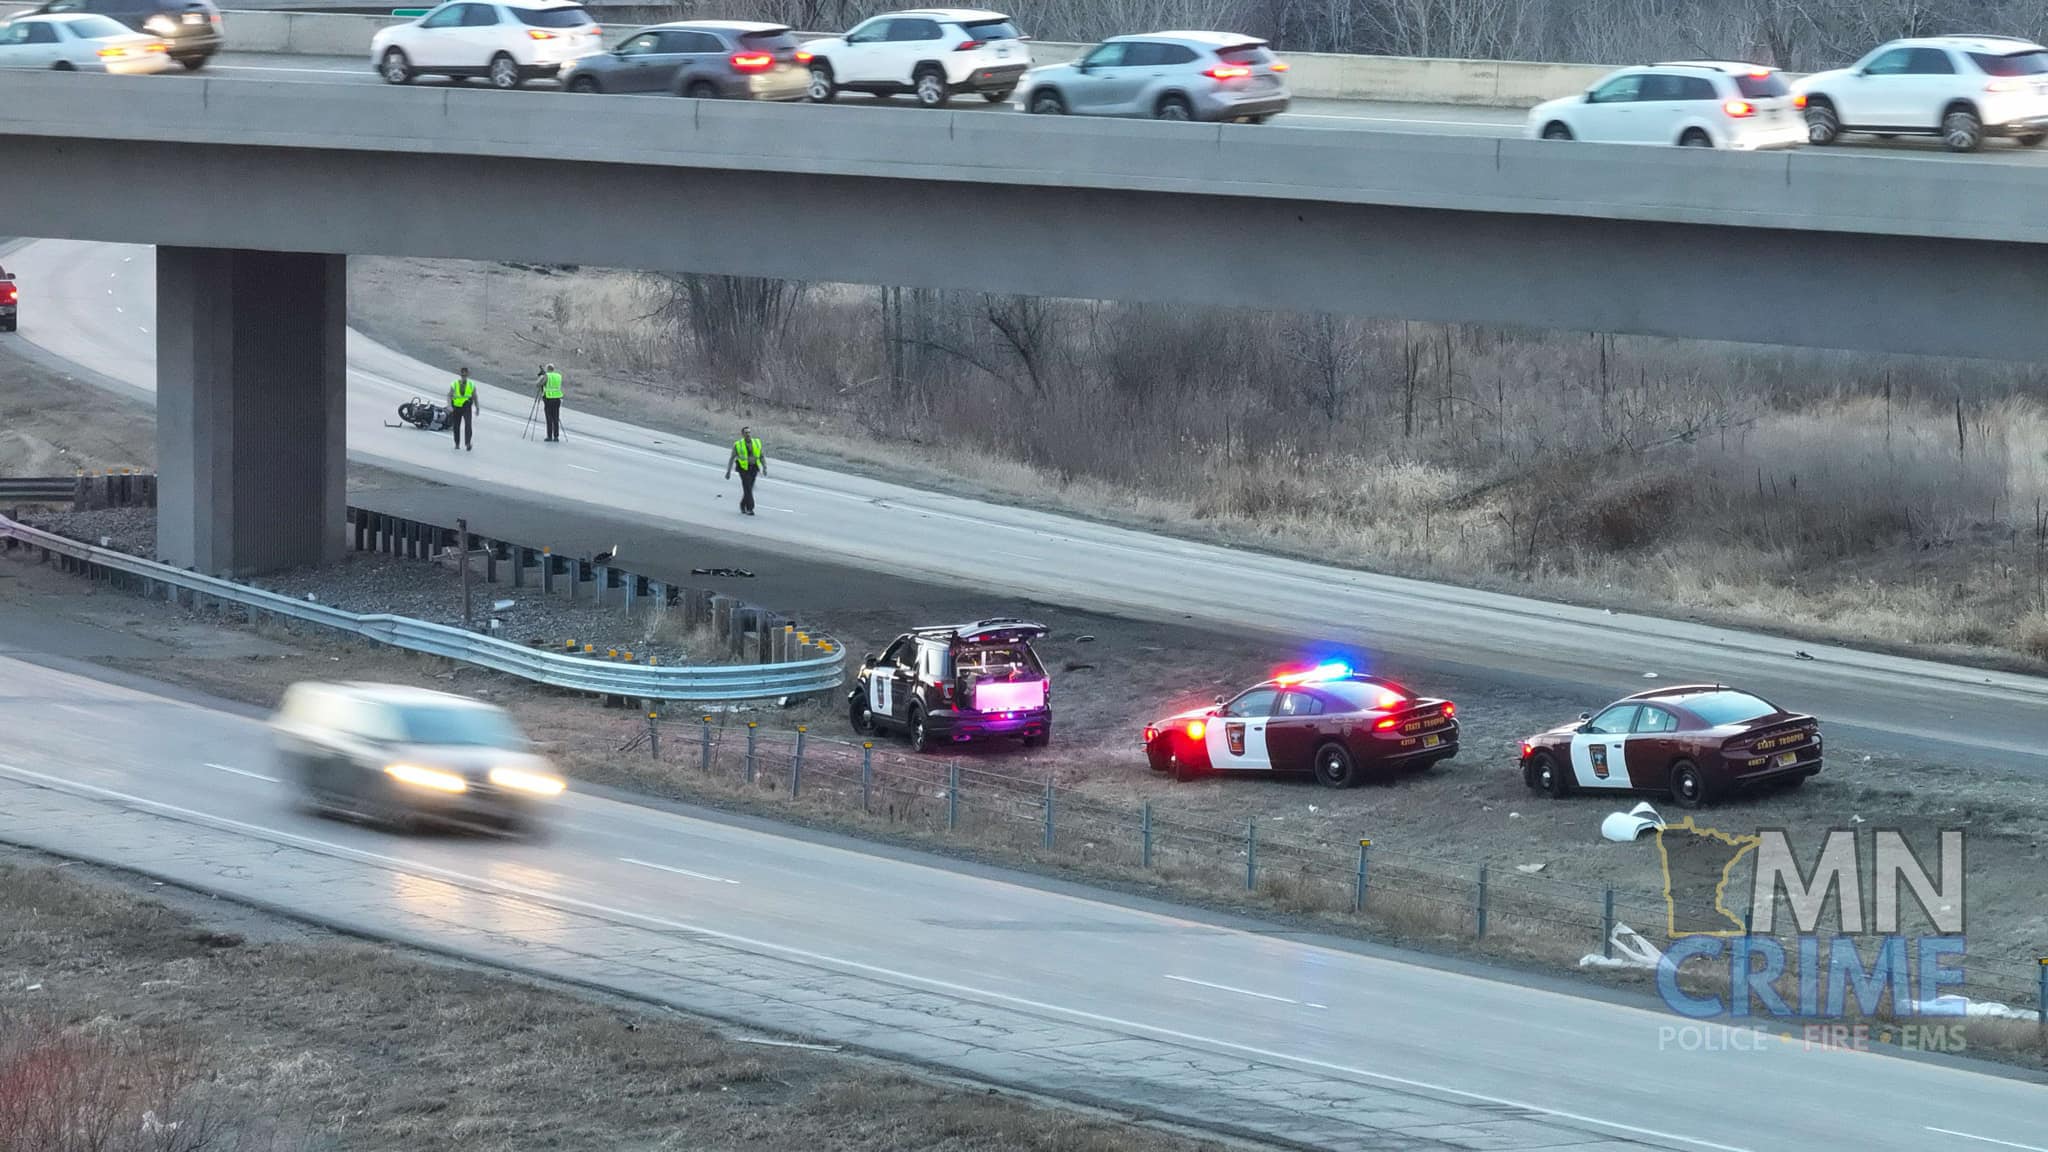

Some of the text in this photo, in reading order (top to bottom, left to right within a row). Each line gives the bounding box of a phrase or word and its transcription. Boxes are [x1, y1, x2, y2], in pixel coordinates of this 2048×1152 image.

[1405, 722, 1421, 731] STATE
[1757, 733, 1804, 750] STATE TROOPER
